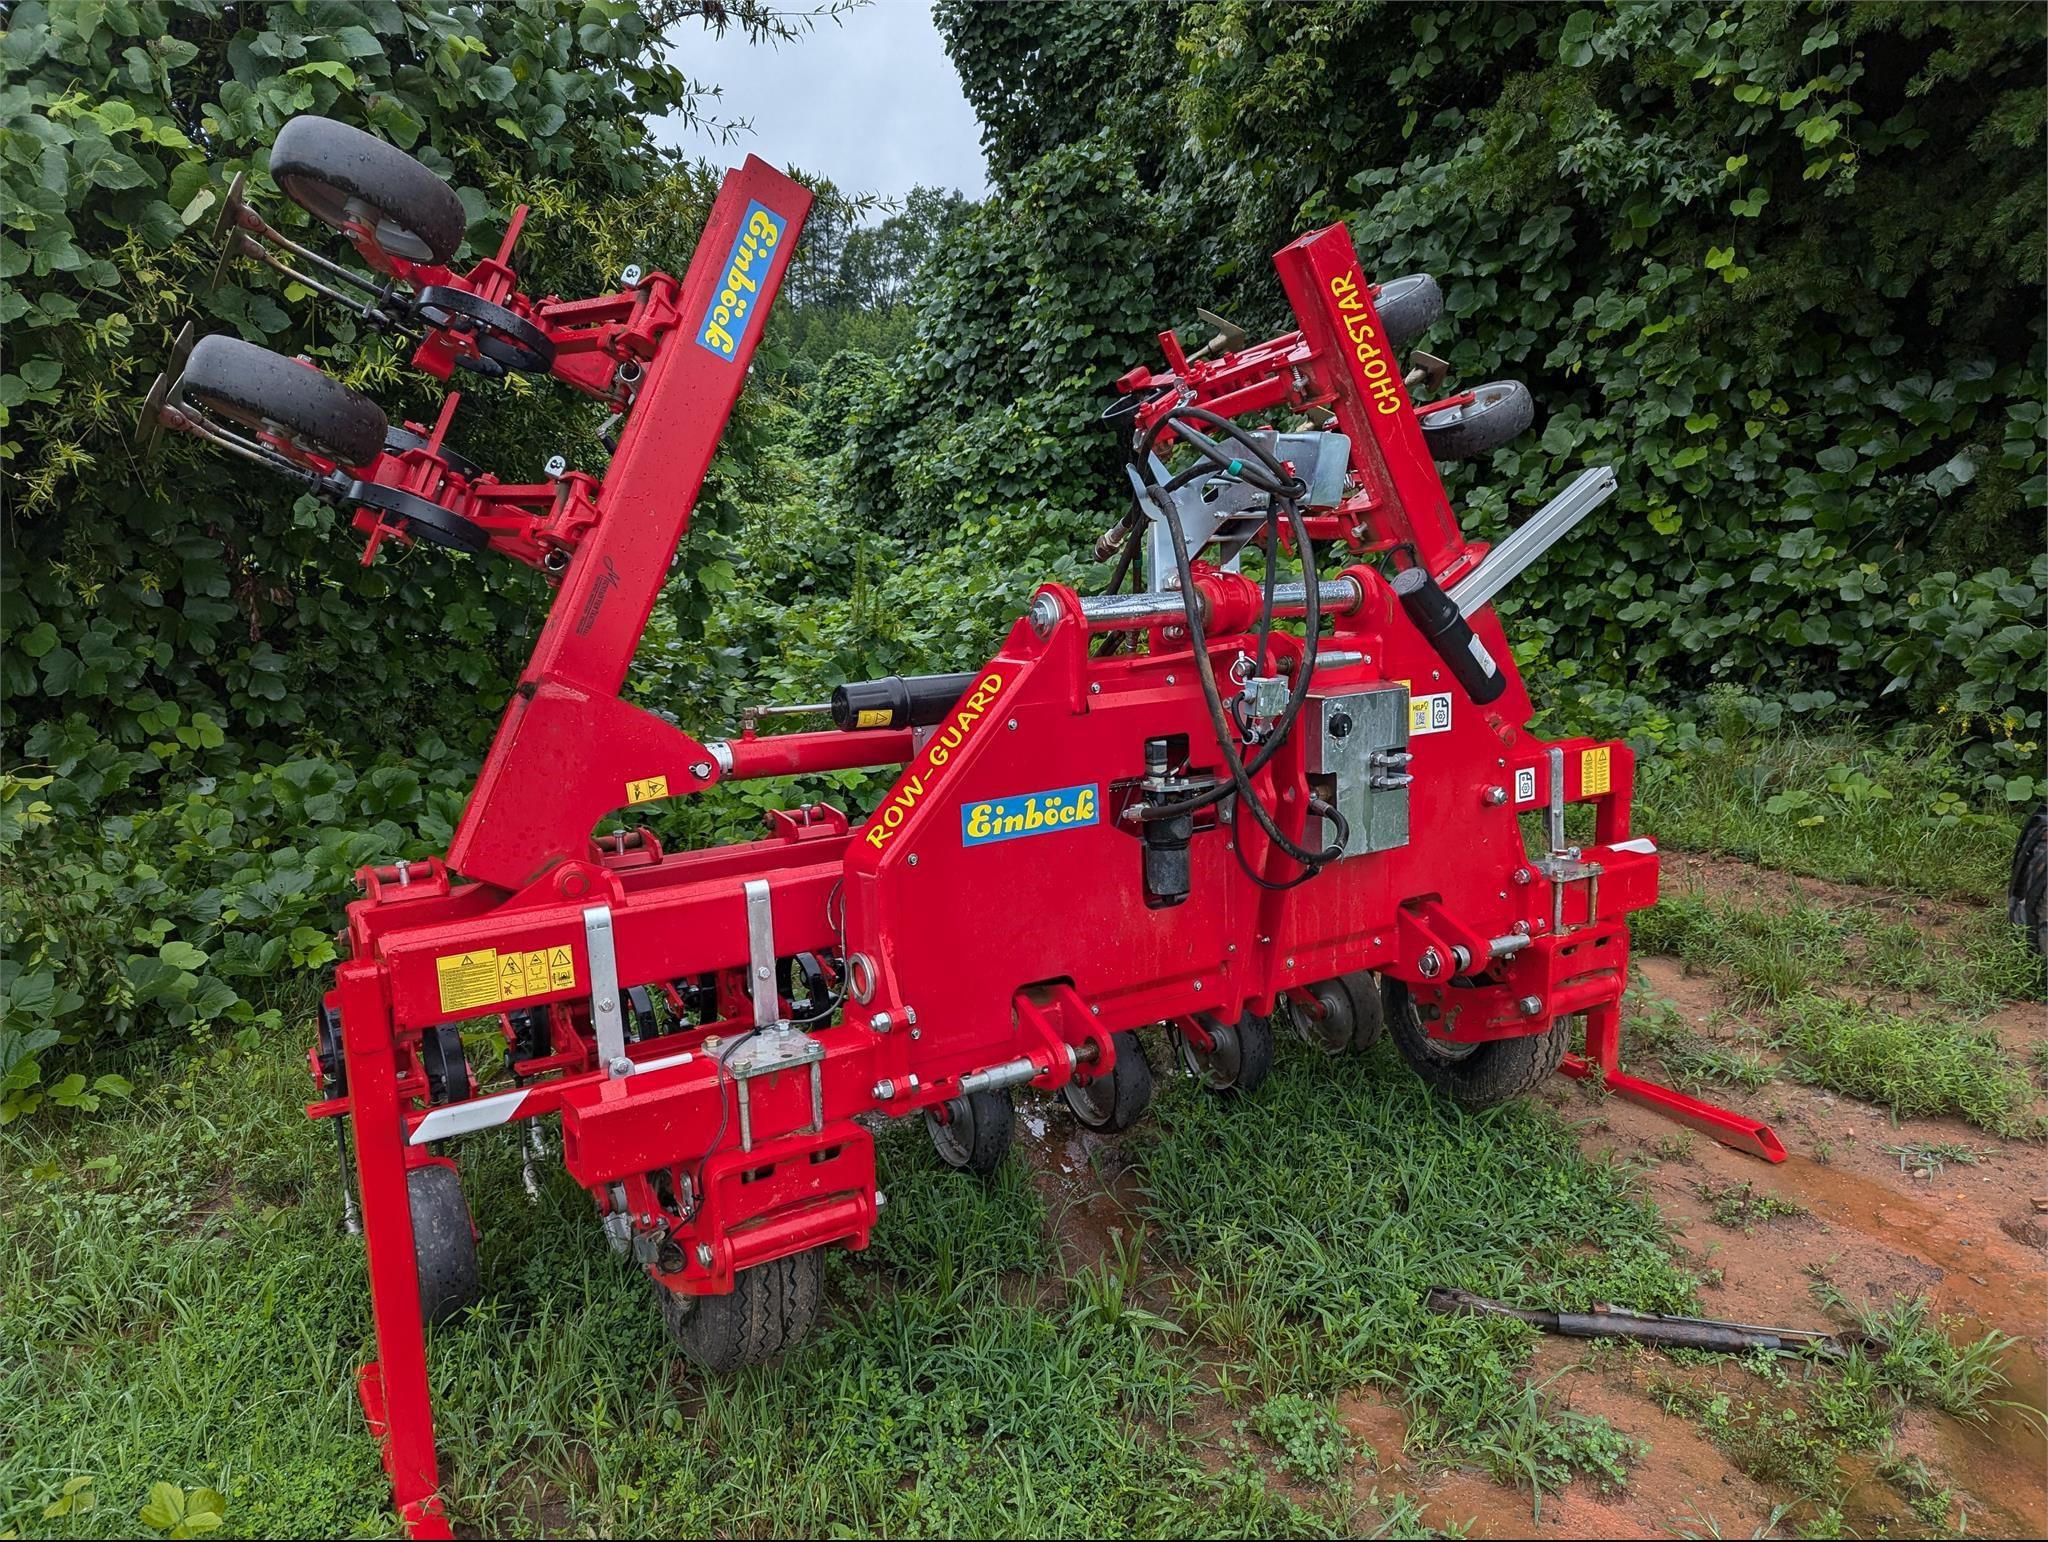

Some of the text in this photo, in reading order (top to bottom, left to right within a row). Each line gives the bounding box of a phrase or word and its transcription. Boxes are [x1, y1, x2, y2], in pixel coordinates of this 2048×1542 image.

[697, 209, 778, 358] Einböck
[1330, 271, 1401, 415] CHOPSTAR
[857, 673, 1004, 849] ROW-GUARD
[967, 787, 1095, 839] Einböck
